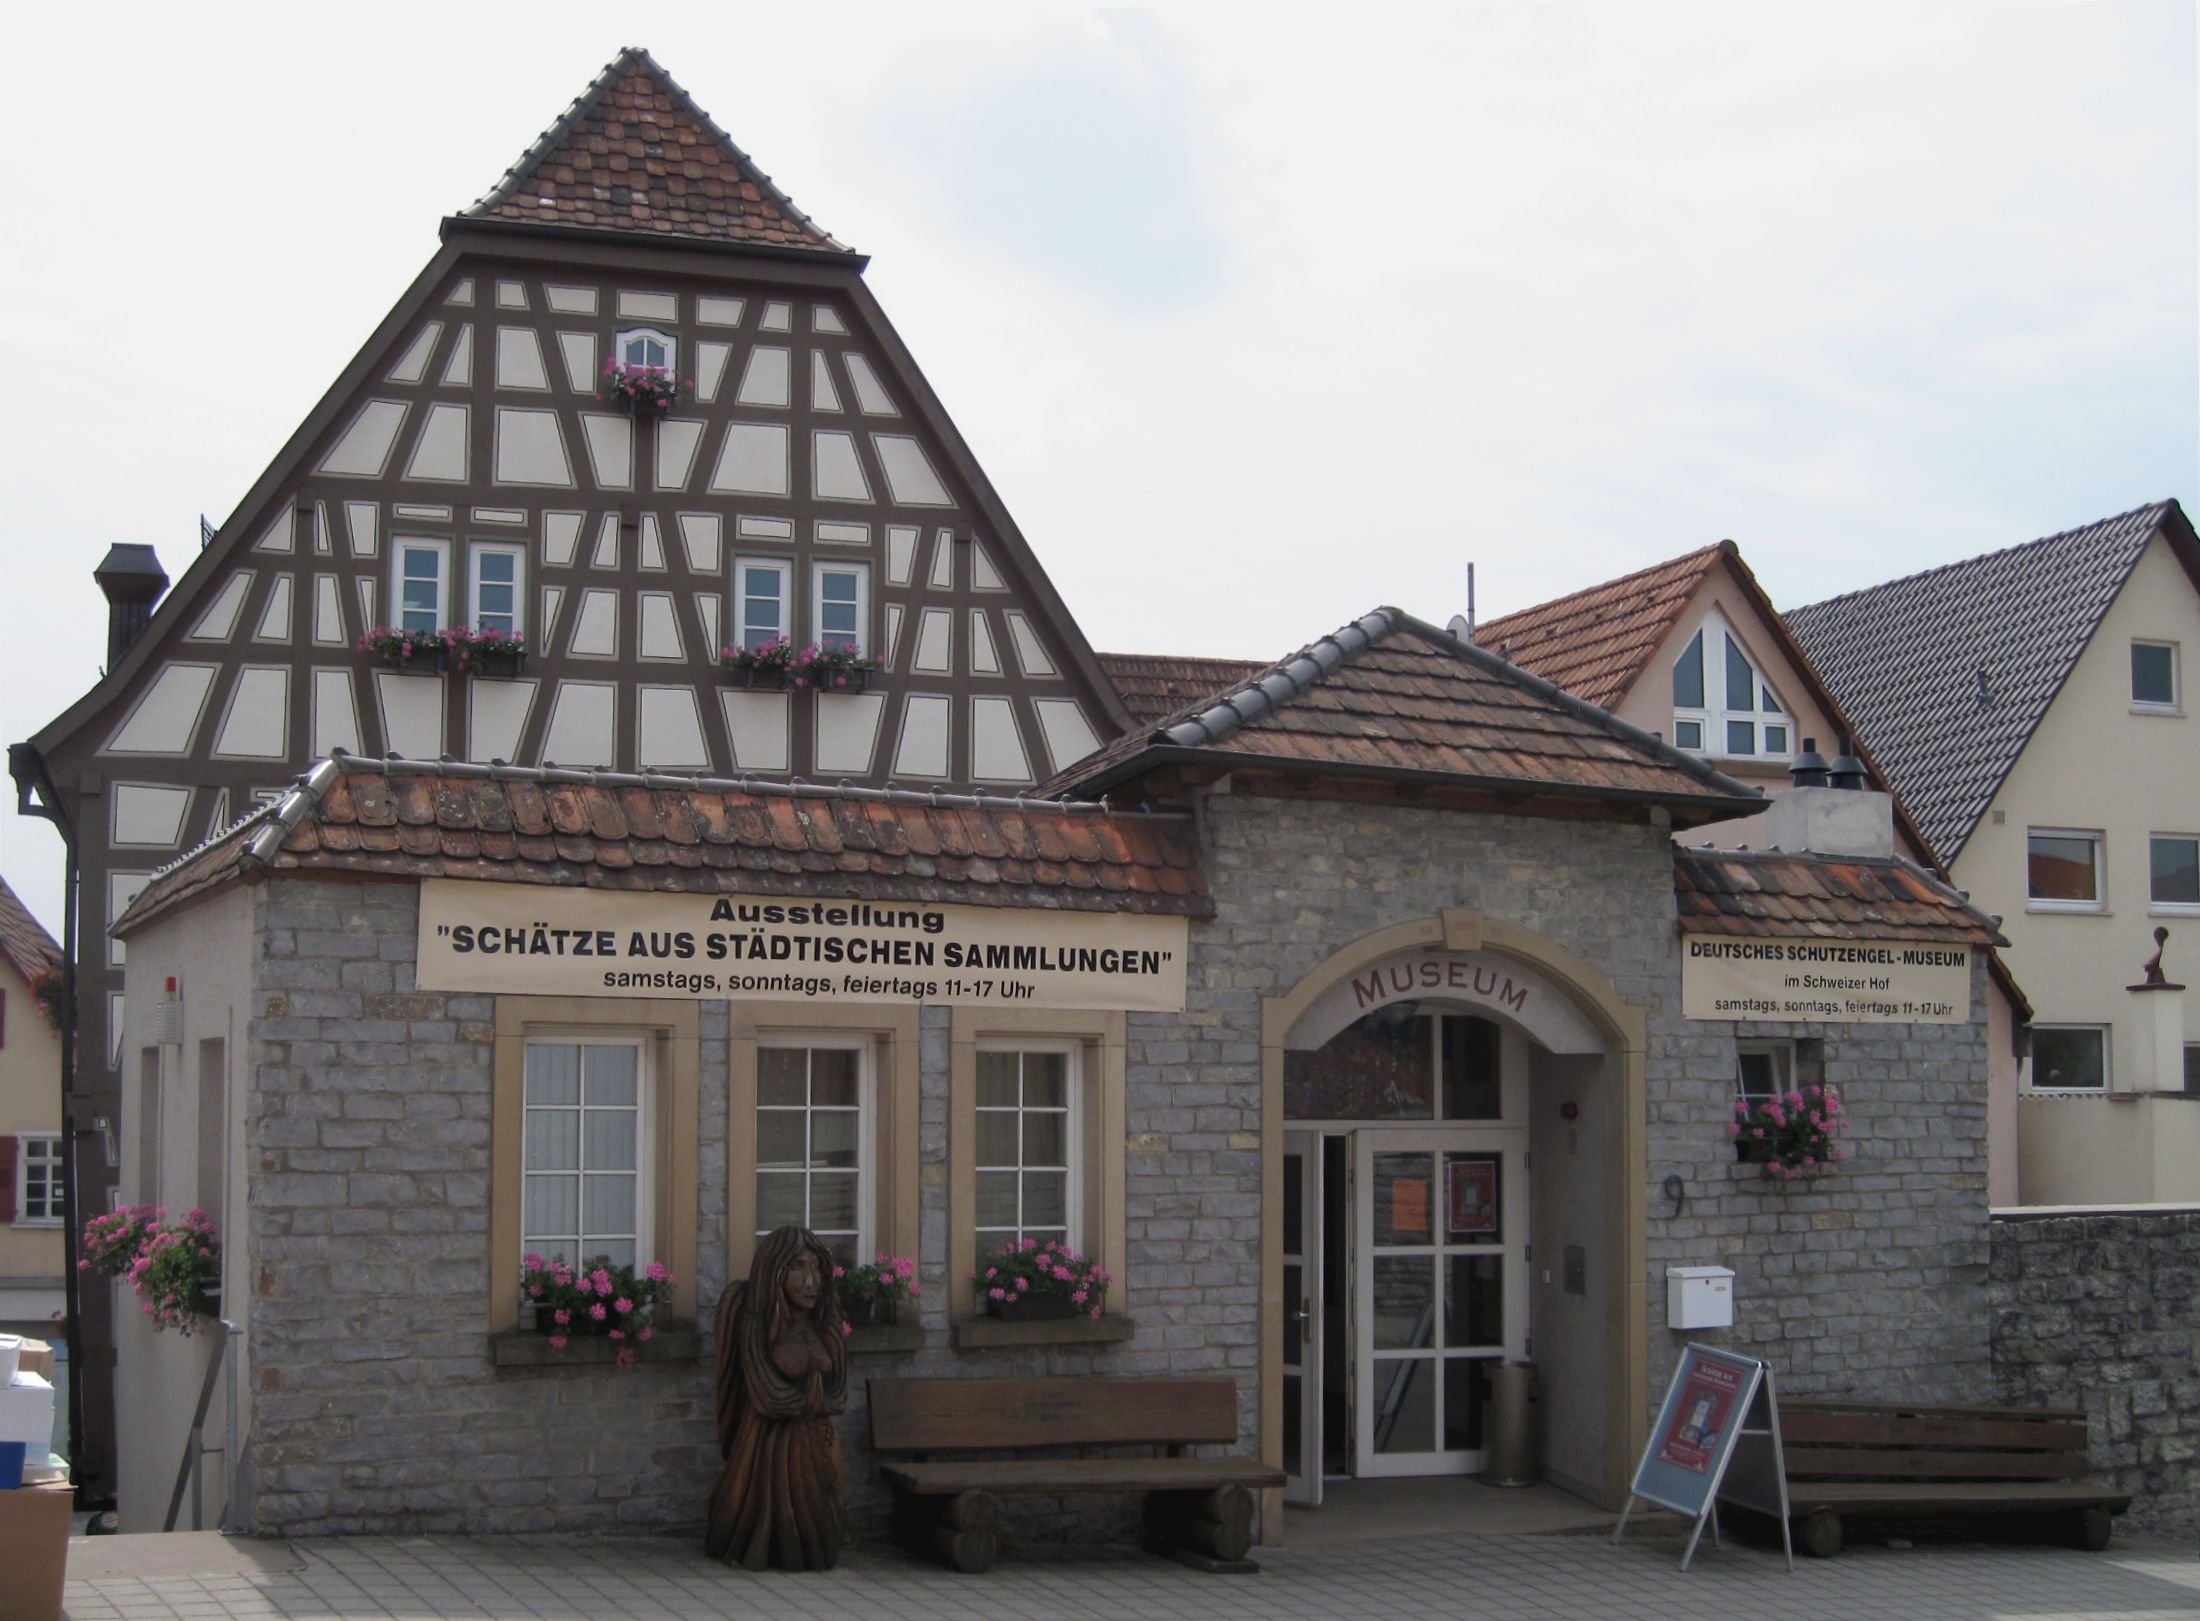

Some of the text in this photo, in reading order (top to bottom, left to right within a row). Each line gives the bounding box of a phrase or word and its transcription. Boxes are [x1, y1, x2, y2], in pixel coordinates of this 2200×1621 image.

[710, 899, 944, 933] Ausstellung
[628, 931, 696, 960] AUS
[706, 927, 934, 966] STÄDTISCHEN
[1690, 941, 1784, 961] DEUTSCHES
[603, 970, 1036, 999] samstags, sonntags, feiertags 11-17 Uhr
[1351, 961, 1529, 1013] MUSEUM
[1784, 975, 1890, 990] im Schweizer Hof
[1715, 998, 1780, 1013] samstags,
[1784, 1000, 1842, 1014] sonntags,
[1845, 1000, 1899, 1016] feiertags
[1933, 1003, 1954, 1015] Uhr
[1664, 1175, 1684, 1217] 9
